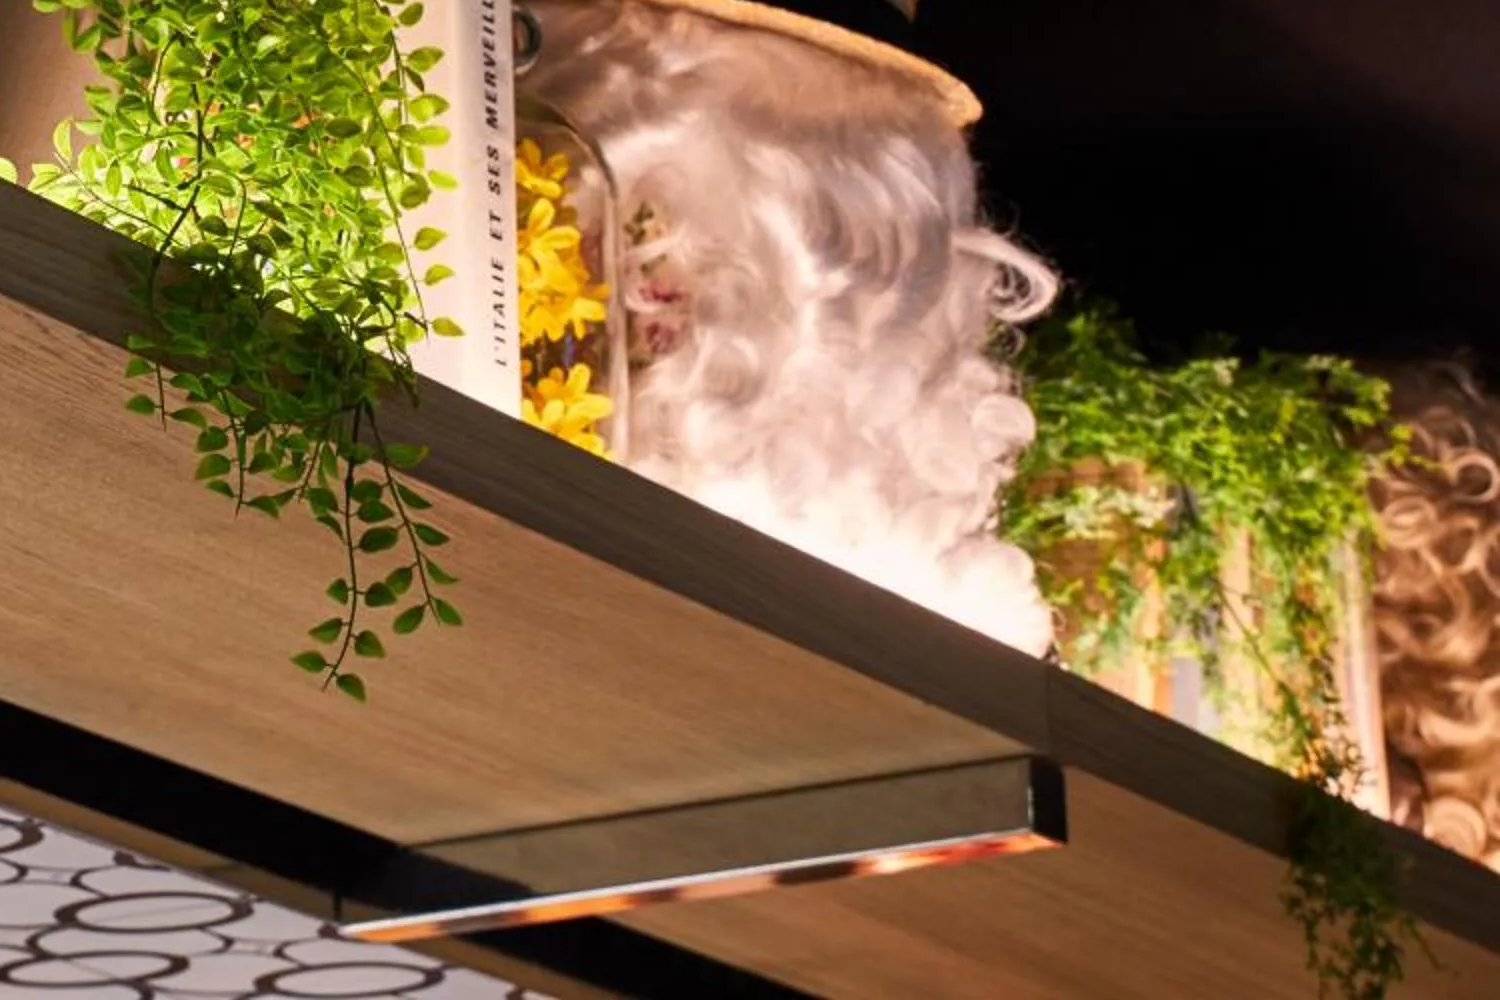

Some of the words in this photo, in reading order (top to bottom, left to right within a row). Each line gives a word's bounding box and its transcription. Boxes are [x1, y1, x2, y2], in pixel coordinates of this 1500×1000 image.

[486, 144, 501, 196] SES
[489, 209, 503, 242] ET
[490, 256, 507, 367] L'ITALIE
